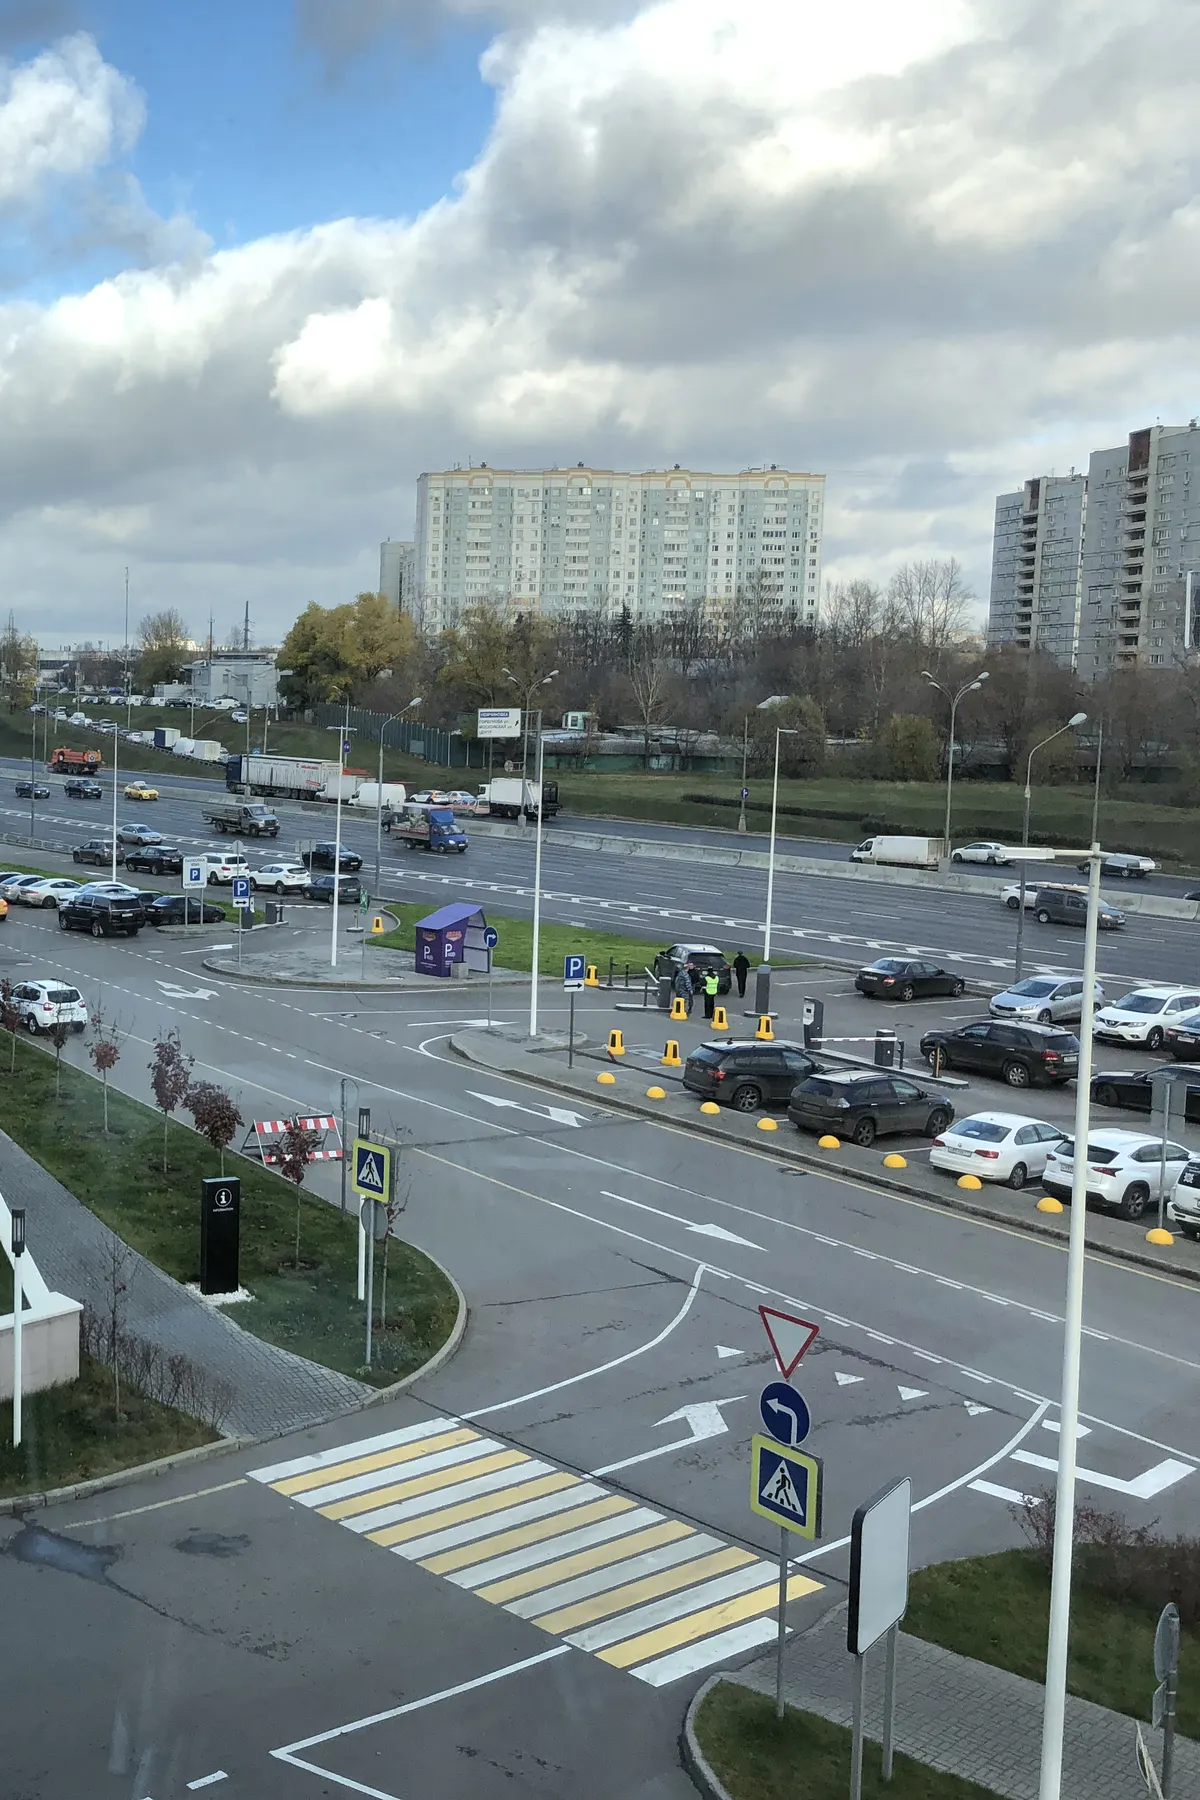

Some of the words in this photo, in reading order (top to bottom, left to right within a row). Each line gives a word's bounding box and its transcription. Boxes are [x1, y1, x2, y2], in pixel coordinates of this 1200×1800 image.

[192, 870, 199, 879] P
[237, 881, 247, 895] P
[570, 957, 582, 977] P
